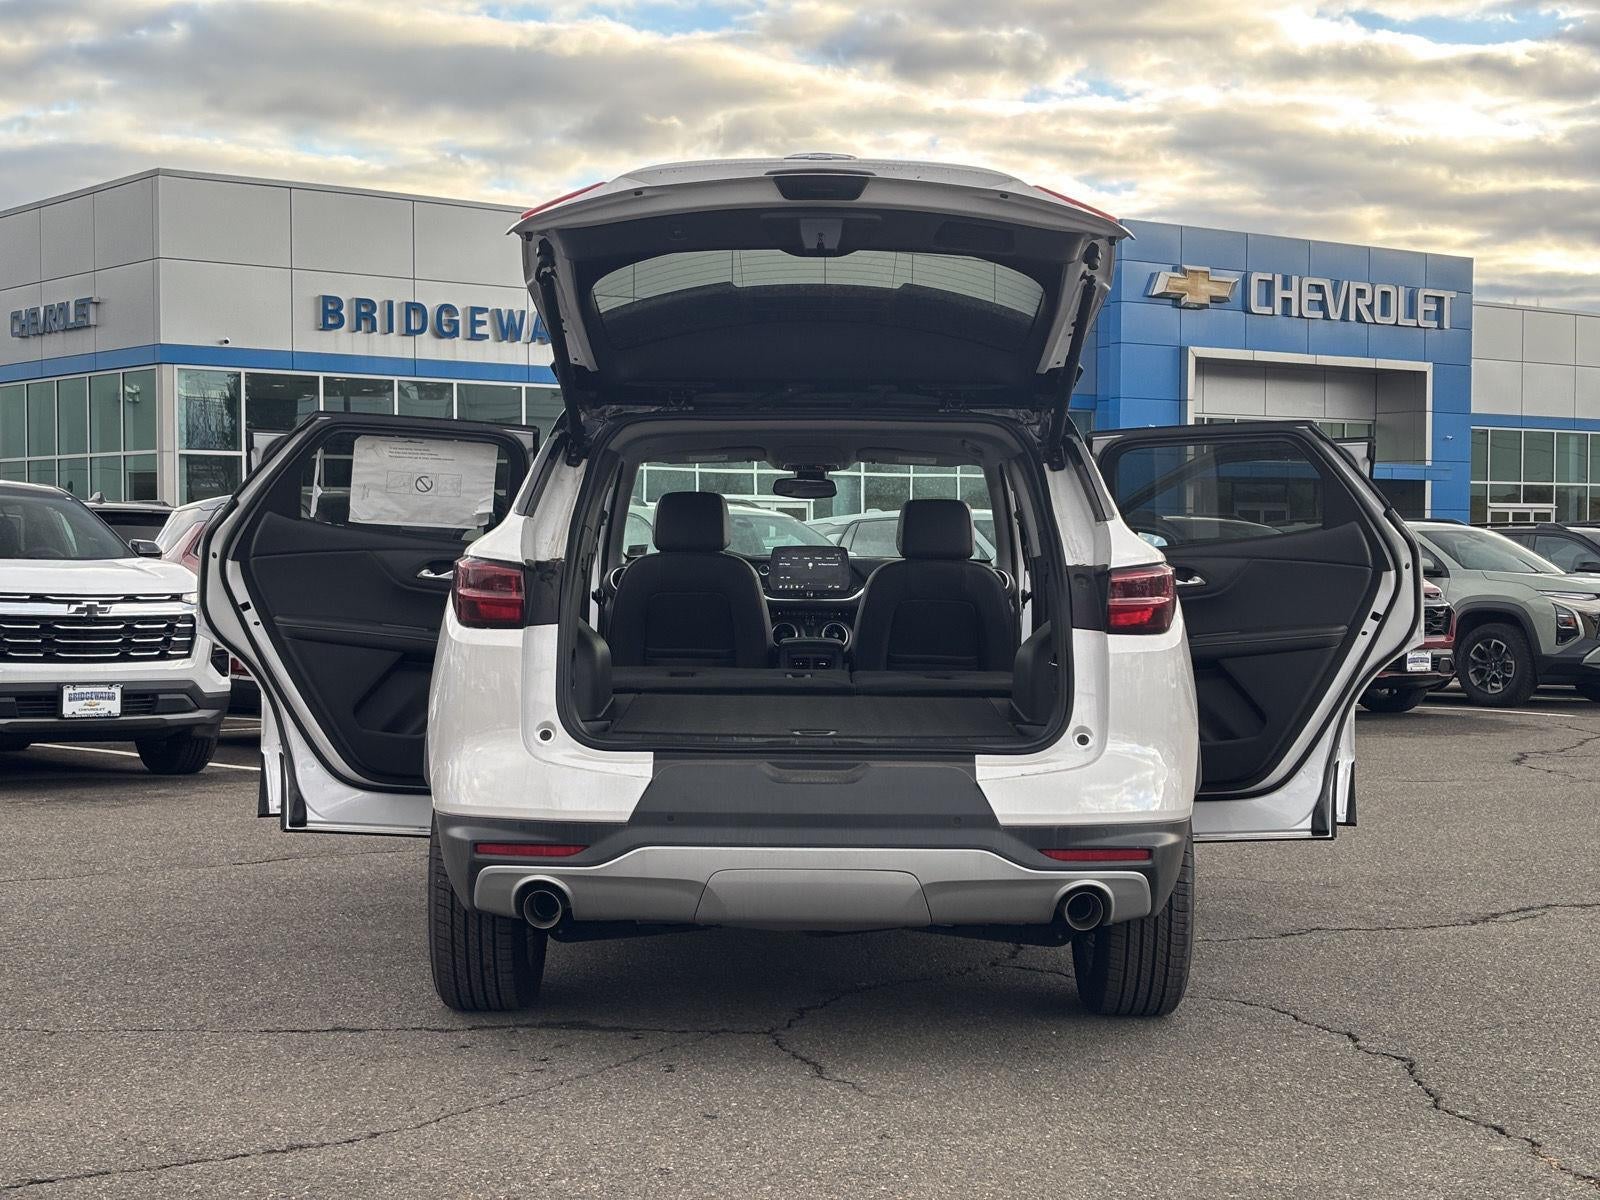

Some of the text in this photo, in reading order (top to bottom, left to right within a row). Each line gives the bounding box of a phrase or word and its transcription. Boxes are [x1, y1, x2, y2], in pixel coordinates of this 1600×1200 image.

[11, 296, 99, 338] CHEVROLET
[1250, 271, 1457, 330] CHEVROLET
[68, 691, 116, 702] BRIDGEWATER
